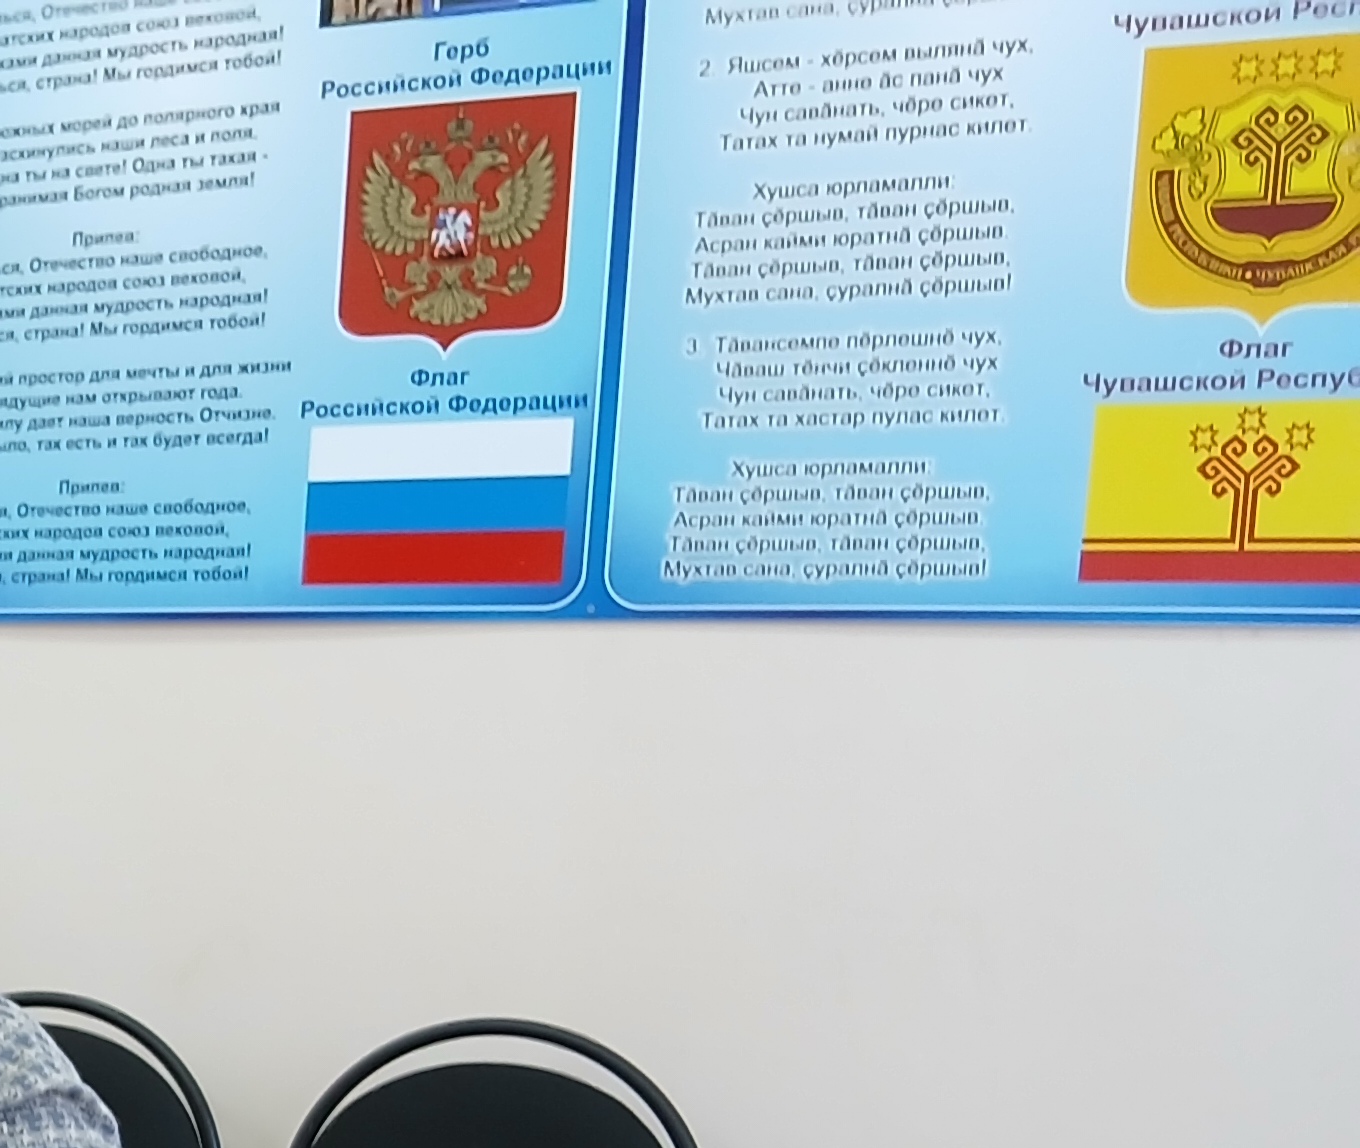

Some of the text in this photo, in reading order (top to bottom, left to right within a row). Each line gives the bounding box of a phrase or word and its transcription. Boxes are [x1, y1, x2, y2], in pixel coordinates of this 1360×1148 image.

[1113, 2, 1281, 40] Чувашской
[433, 37, 490, 64] Герб
[728, 55, 800, 75] Яшсем
[992, 38, 1033, 59] чух,
[320, 60, 612, 100] Российской Федерации
[753, 79, 802, 99] Атте
[822, 77, 873, 94] анне
[968, 67, 1004, 87] чух
[60, 114, 113, 134] морей
[115, 114, 139, 132] до
[143, 104, 236, 126] полярного
[239, 101, 281, 119] края
[740, 106, 778, 128] Чун
[950, 93, 1014, 111] сикет,
[100, 138, 146, 153] наши
[150, 133, 190, 149] леса
[194, 132, 206, 145] и
[721, 133, 778, 151] Татах
[786, 133, 807, 147] та
[813, 126, 879, 149] нумай
[885, 123, 960, 145] пурнас
[25, 169, 47, 183] ты
[51, 167, 71, 180] на
[75, 158, 128, 179] свете!
[132, 156, 176, 174] Одна
[181, 156, 205, 170] ты
[209, 150, 257, 167] такая
[73, 184, 125, 203] Богом
[129, 180, 192, 201] родная
[197, 170, 255, 192] земля!
[72, 230, 138, 249] Припев:
[29, 255, 116, 274] Отечество
[120, 252, 164, 267] наше
[168, 244, 268, 264] свободное,
[47, 278, 118, 296] народов
[122, 275, 166, 290] союз
[170, 268, 247, 287] вековой,
[29, 302, 89, 321] данная
[93, 297, 174, 318] мудрость
[179, 287, 269, 310] народная!
[23, 321, 85, 344] страна!
[89, 321, 118, 336] Мы
[122, 318, 204, 336] гордимся
[209, 311, 266, 330] тобой!
[961, 330, 1002, 349] чух,
[1219, 338, 1293, 359] Флаг
[18, 370, 86, 387] простор
[88, 368, 121, 385] для
[125, 366, 180, 380] мечты
[184, 365, 195, 378] и
[198, 363, 233, 380] для
[237, 360, 292, 375] жизни
[410, 368, 470, 387] Флаг
[962, 357, 998, 375] чух
[65, 393, 97, 405] нам
[101, 387, 196, 405] открывают
[719, 386, 757, 407] Чун
[926, 382, 990, 399] сикет,
[1083, 372, 1246, 399] Чувашской
[300, 393, 588, 420] Российской Федерации
[68, 414, 111, 428] наша
[115, 410, 195, 430] верность
[702, 411, 759, 429] Татах
[768, 413, 788, 427] та
[795, 412, 865, 430] хастар
[872, 410, 933, 428] пулас
[37, 439, 62, 452] так
[65, 437, 102, 451] есть
[107, 437, 117, 449] и
[123, 436, 148, 449] так
[152, 431, 201, 451] будет
[206, 426, 270, 447] всегда!
[733, 460, 929, 481] Хушса юрламалли:
[58, 478, 123, 497] Припев:
[16, 502, 101, 519] Отечество
[105, 503, 149, 516] наше
[153, 497, 251, 516] свободное,
[34, 526, 103, 543] народов
[107, 525, 150, 539] союз
[155, 522, 230, 538] вековой,
[674, 511, 735, 531] Асран
[741, 512, 804, 527] кайми
[16, 549, 75, 564] данная
[79, 547, 159, 565] мудрость
[163, 542, 252, 562] народная!
[11, 567, 71, 587] страна!
[75, 567, 103, 583] Мы
[107, 569, 188, 584] гордимся
[193, 565, 249, 582] тобой!
[664, 560, 738, 579] Мухтав
[743, 563, 795, 580] сана,
